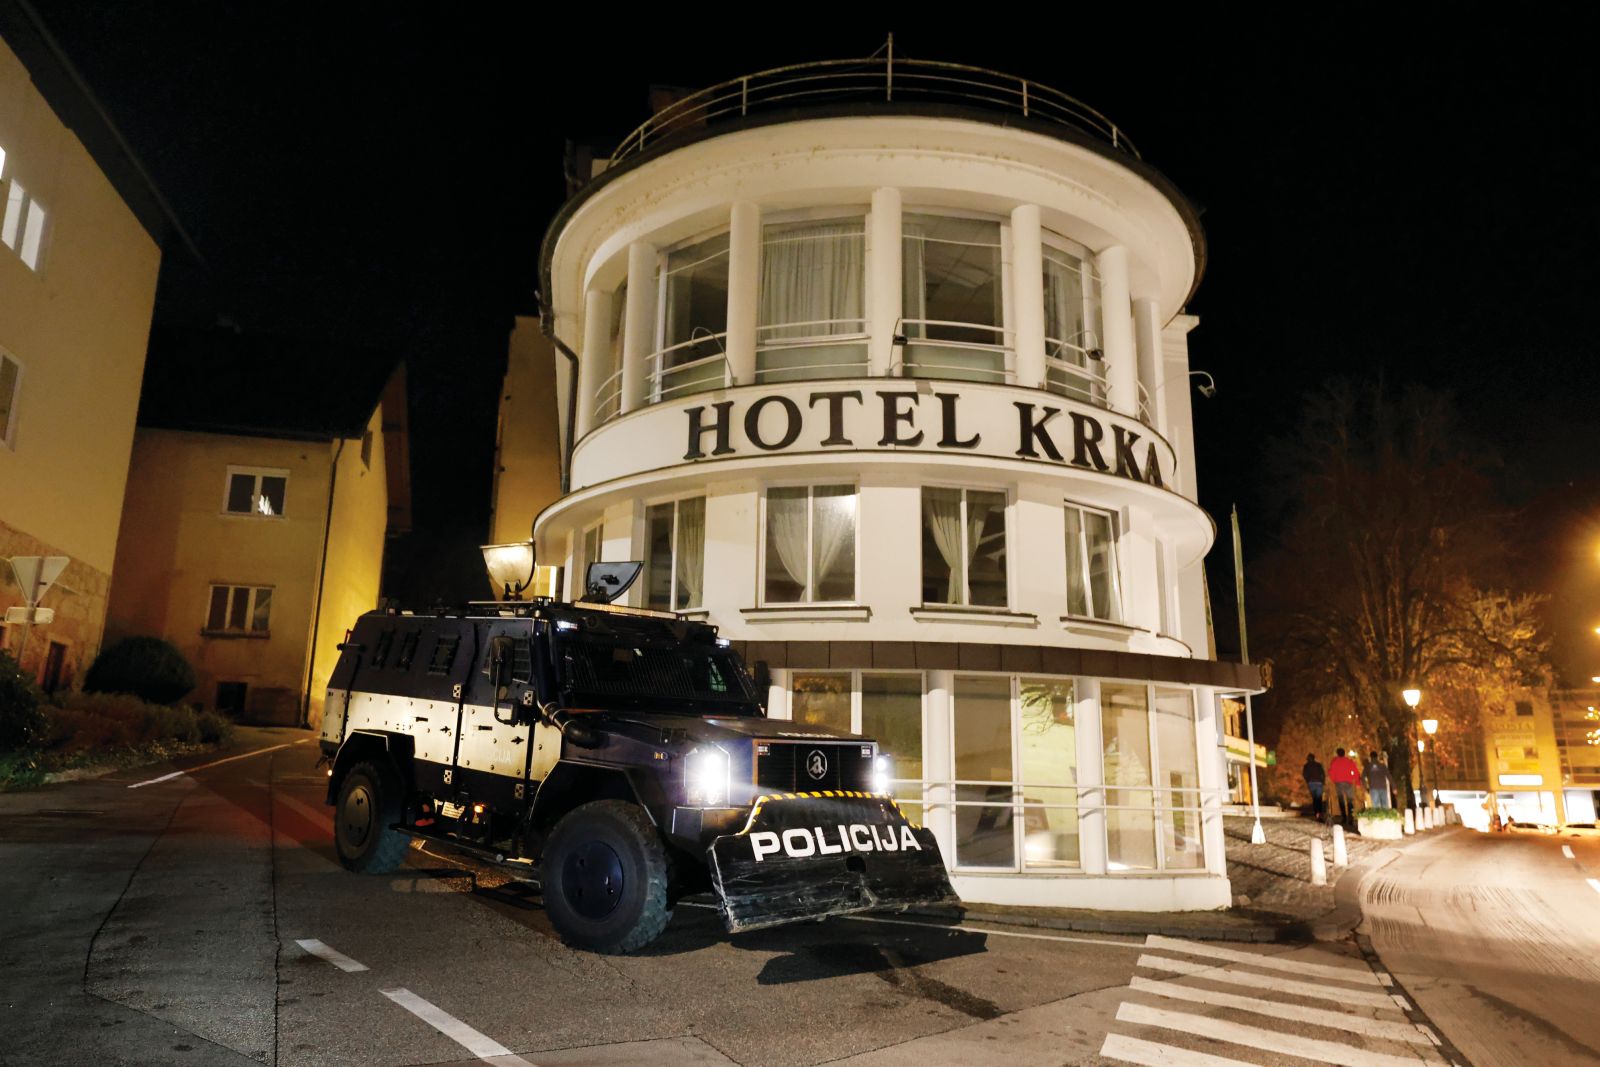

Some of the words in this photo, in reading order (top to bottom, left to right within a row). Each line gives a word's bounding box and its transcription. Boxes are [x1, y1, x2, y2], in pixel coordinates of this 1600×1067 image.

[683, 390, 981, 461] HOTEL
[1013, 401, 1163, 488] KRKA
[750, 824, 922, 862] POLICIJA
